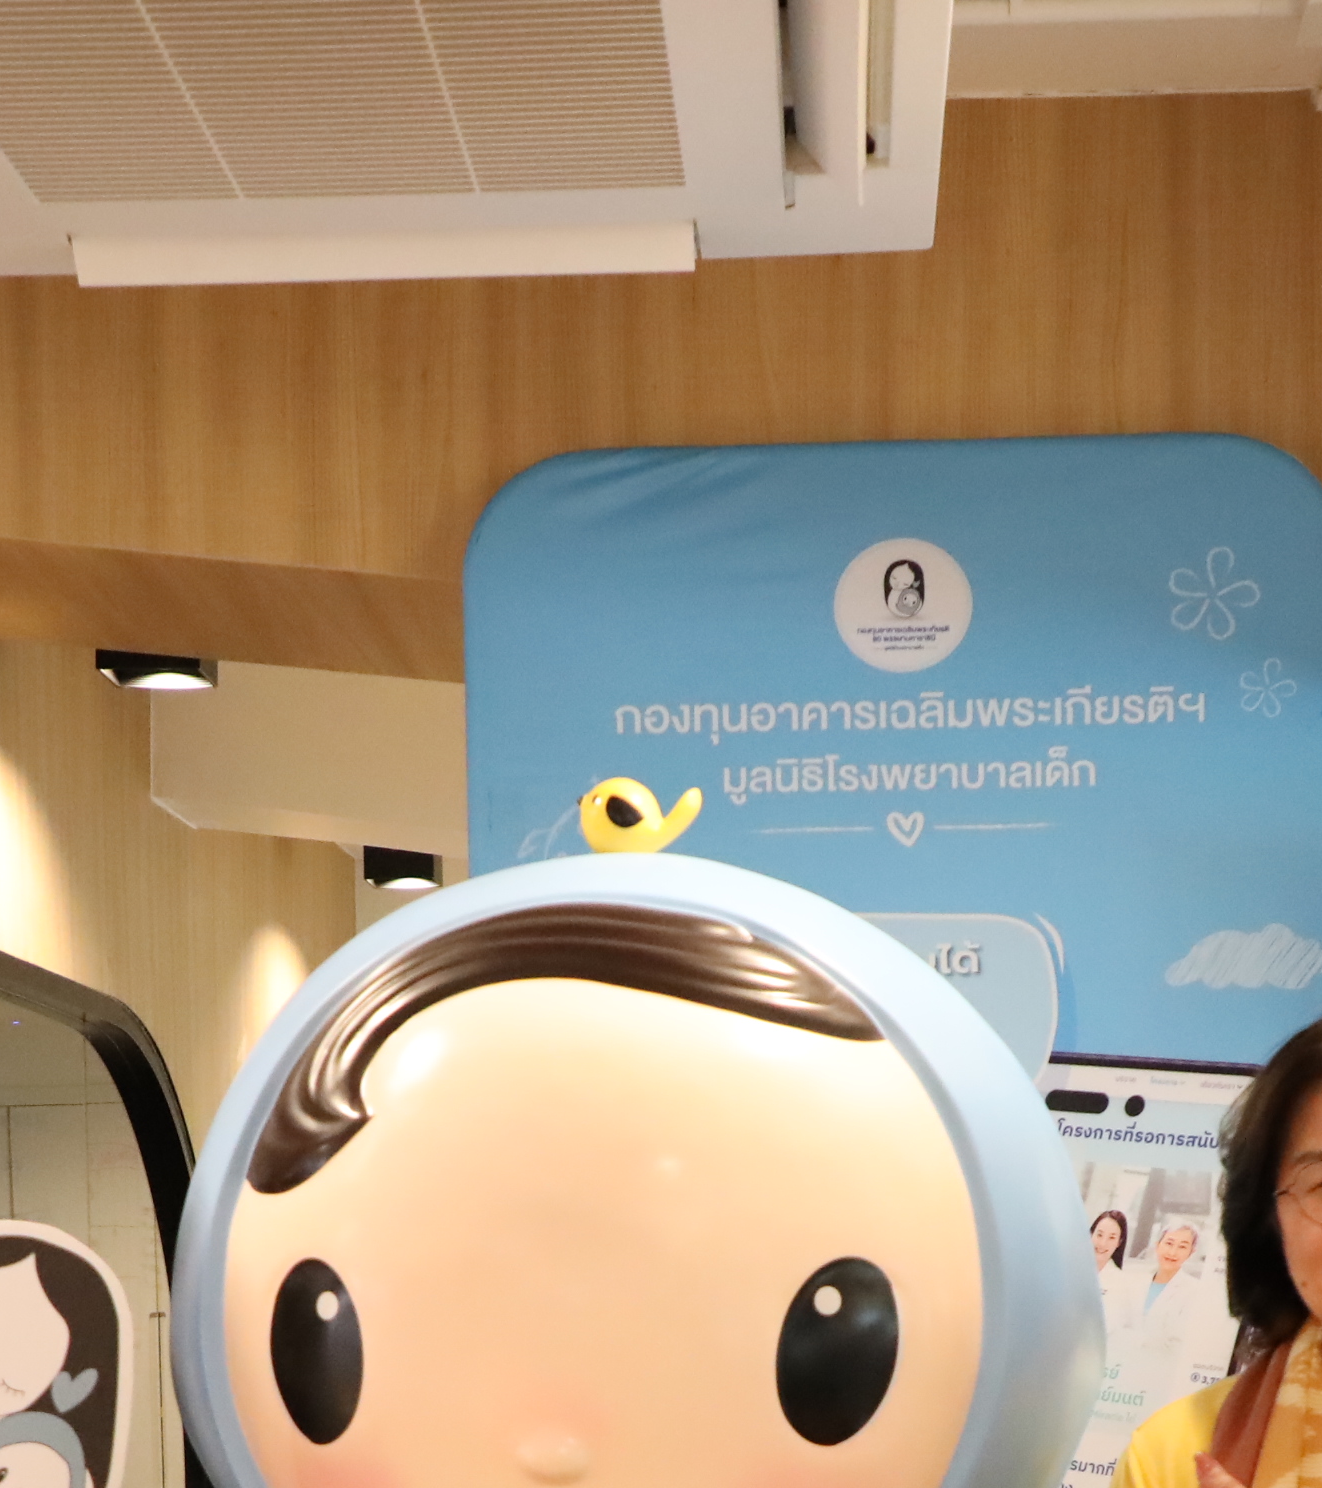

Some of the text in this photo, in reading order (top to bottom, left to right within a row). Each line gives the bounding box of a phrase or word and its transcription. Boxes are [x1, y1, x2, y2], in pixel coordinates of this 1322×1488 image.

[615, 684, 1206, 744] กองทุนอาคารเฉลิมพระเกียรติฯ
[723, 746, 1096, 804] มูลนิธิโรงพยาบาลเด็ก
